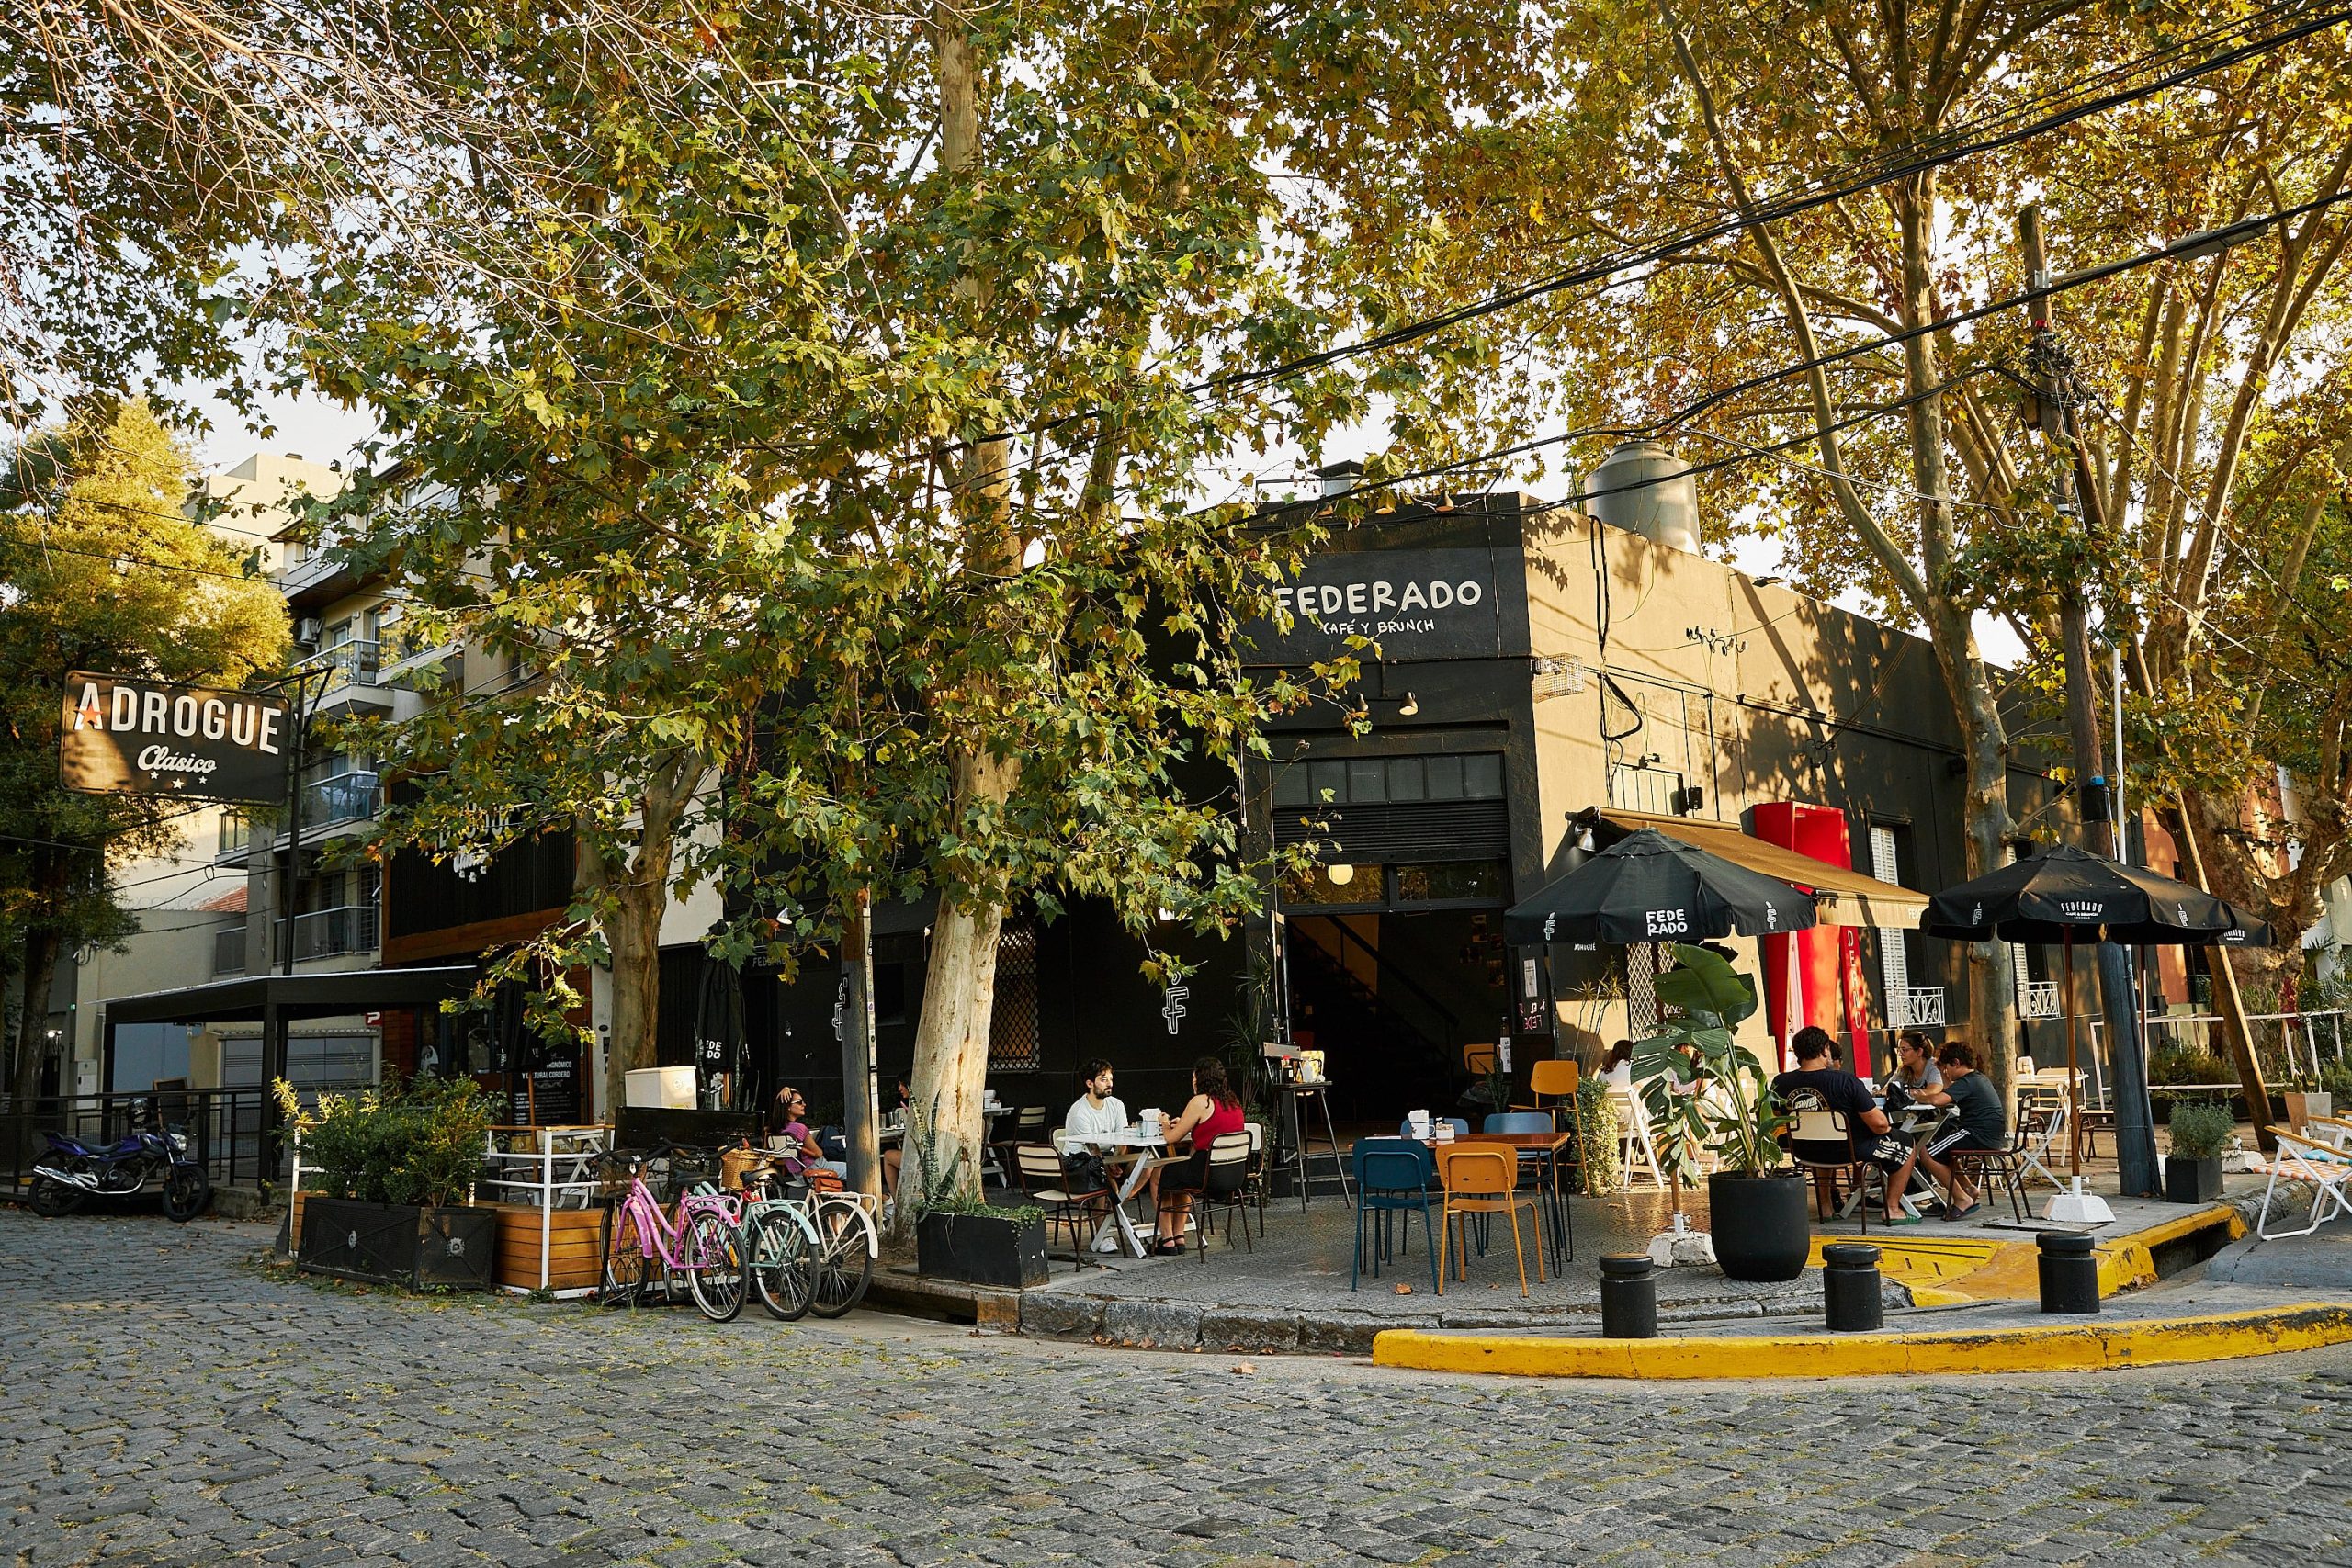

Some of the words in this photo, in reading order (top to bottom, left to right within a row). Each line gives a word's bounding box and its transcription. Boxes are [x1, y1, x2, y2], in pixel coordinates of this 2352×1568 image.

[1274, 581, 1482, 617] FEDERADO
[1323, 618, 1355, 635] CAFÉ
[1360, 622, 1370, 634] Y
[1378, 618, 1435, 634] BRUNCH
[74, 682, 282, 755] ADROGUE
[138, 745, 217, 774] Clásico
[1645, 908, 1685, 924] FEDE
[1647, 922, 1688, 937] RADO
[367, 1011, 381, 1024] P
